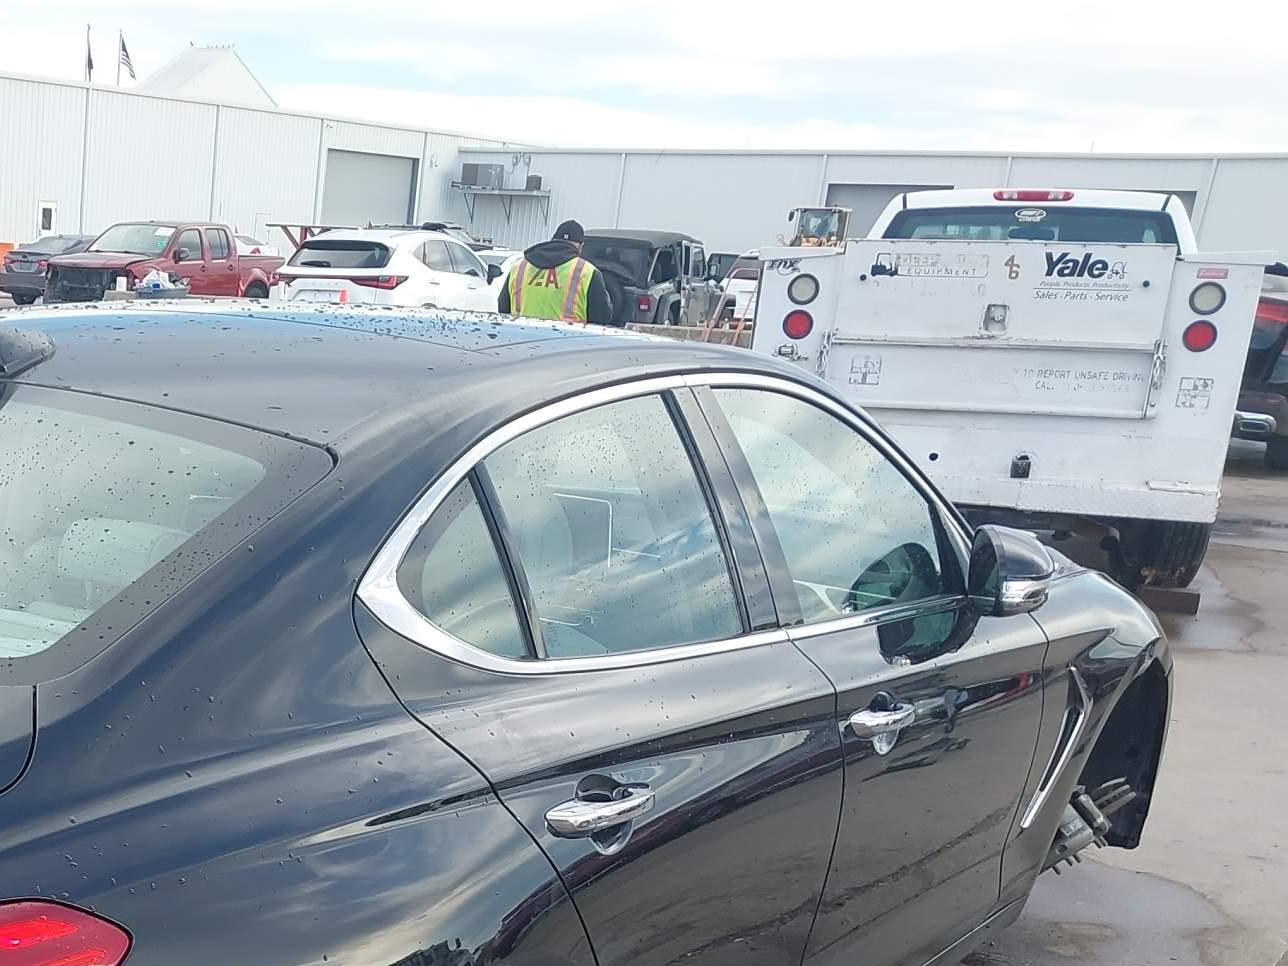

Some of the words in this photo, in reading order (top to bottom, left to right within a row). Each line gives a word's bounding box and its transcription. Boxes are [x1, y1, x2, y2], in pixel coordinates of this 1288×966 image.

[907, 266, 977, 276] EQUIPMENT
[1044, 251, 1109, 279] Yale
[1033, 290, 1058, 300] Sales
[1064, 291, 1087, 301] Parts
[1094, 291, 1129, 302] Service
[1037, 369, 1071, 379] REPORT
[1075, 370, 1110, 381] UNSAFE
